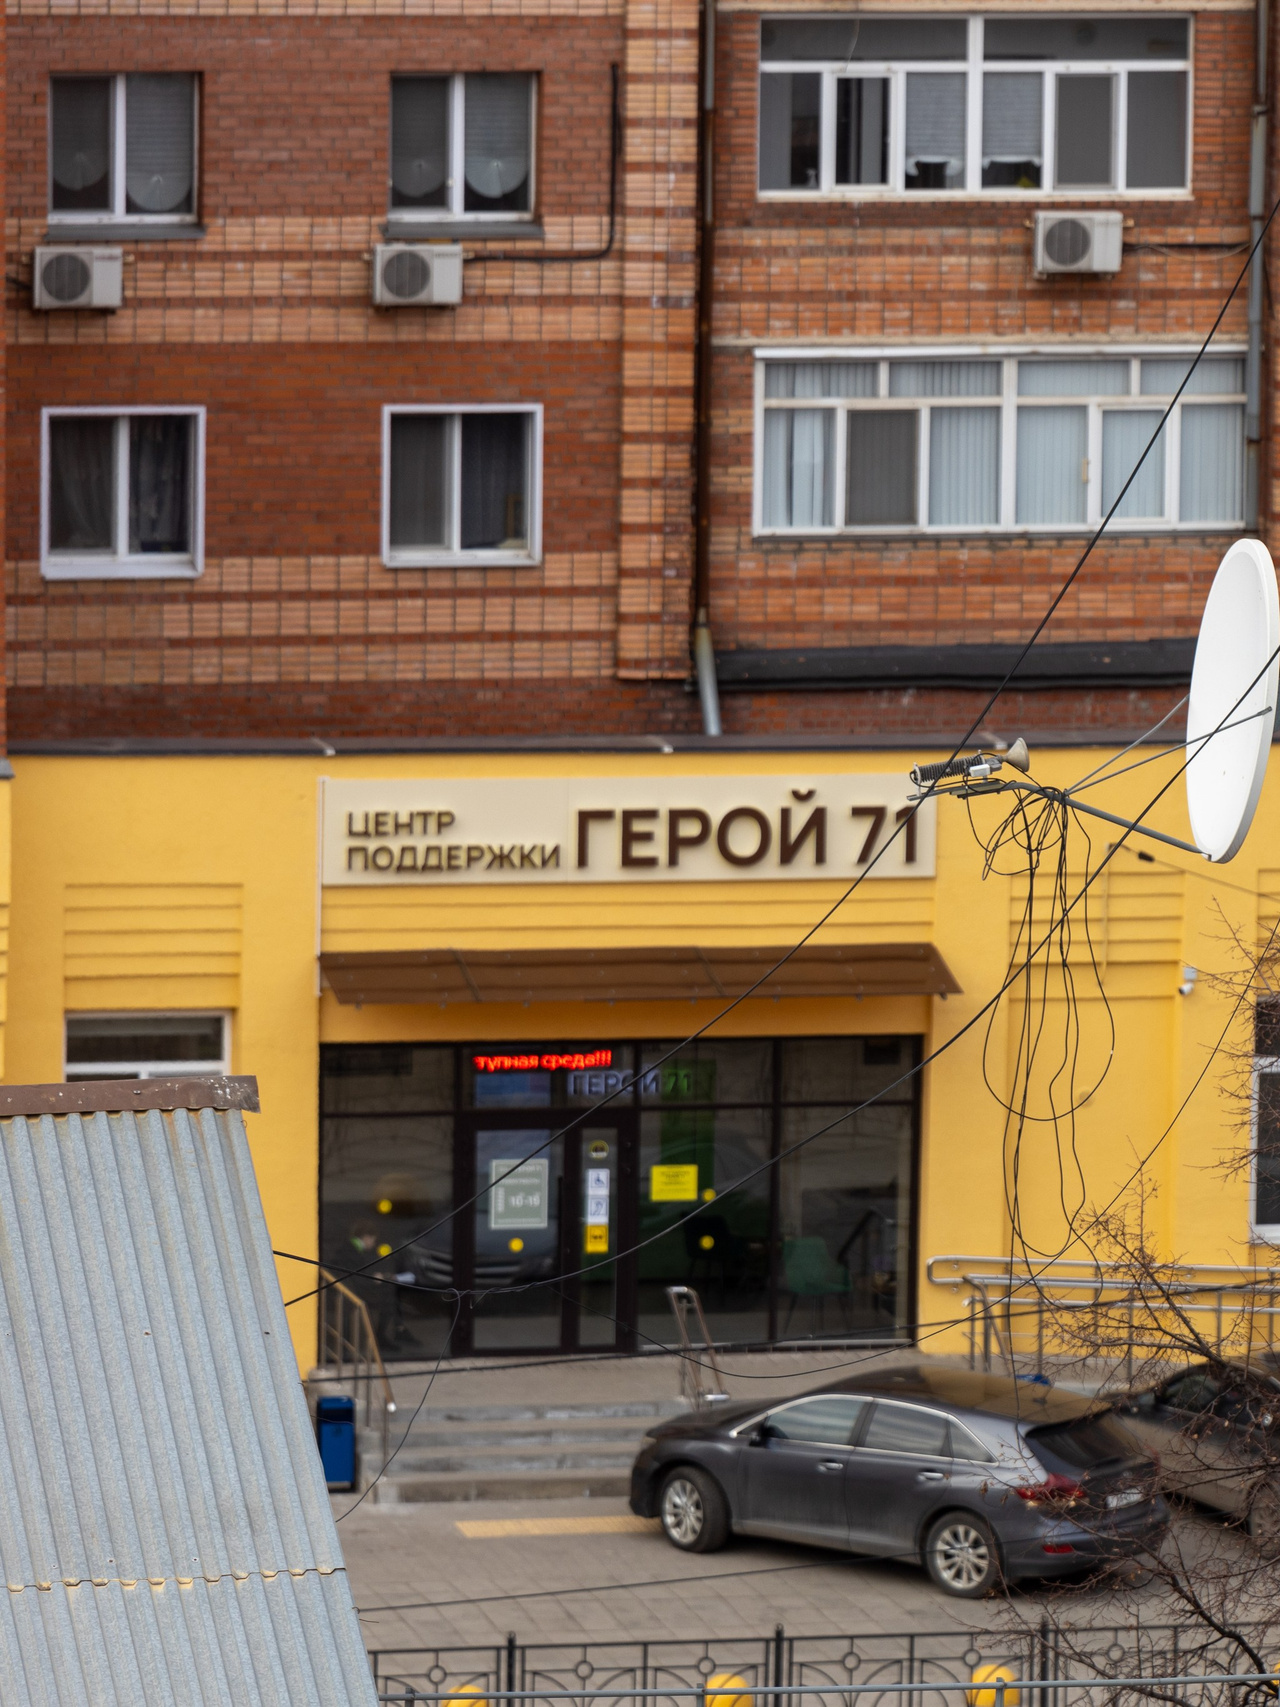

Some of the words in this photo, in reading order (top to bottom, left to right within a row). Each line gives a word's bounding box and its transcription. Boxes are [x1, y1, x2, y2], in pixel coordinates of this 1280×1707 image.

[346, 810, 456, 839] ЦЕНТР
[576, 789, 827, 868] ГЕРОЙ
[850, 804, 919, 865] 71
[346, 843, 561, 873] ПОДДЕРЖКИ
